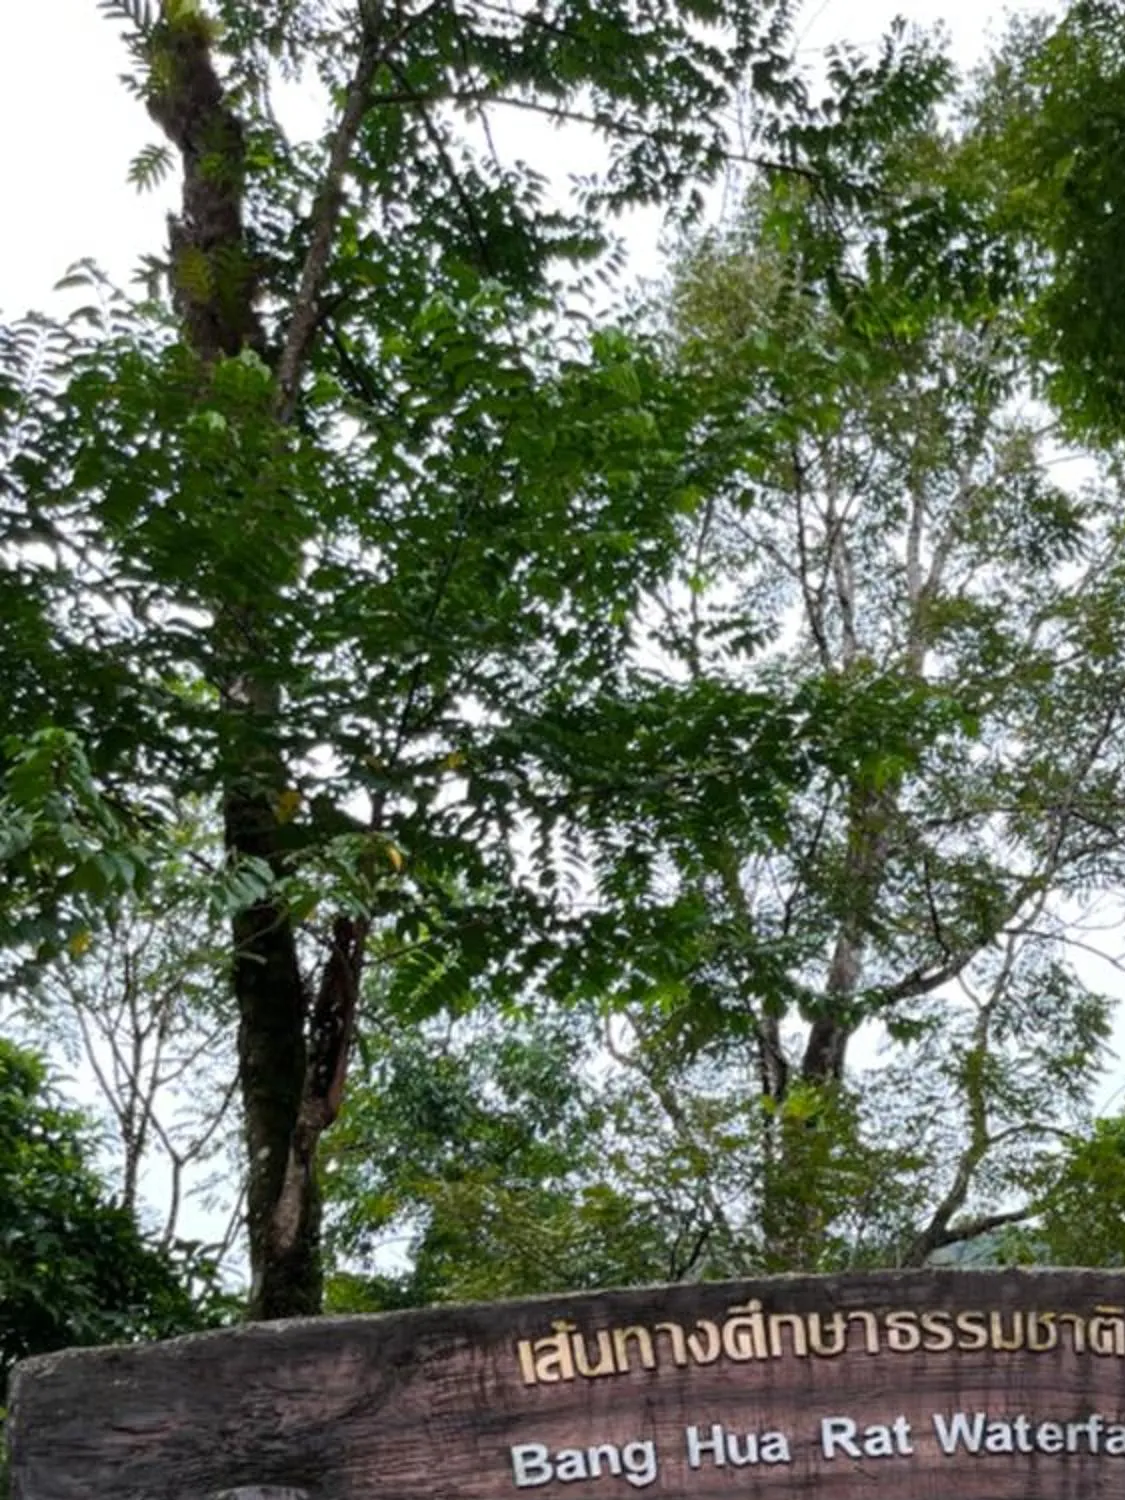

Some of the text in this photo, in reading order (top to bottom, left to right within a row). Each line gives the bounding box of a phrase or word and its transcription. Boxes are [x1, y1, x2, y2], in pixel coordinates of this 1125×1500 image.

[511, 1443, 659, 1489] Bang
[686, 1425, 793, 1468] Hua
[821, 1415, 914, 1459] Rat
